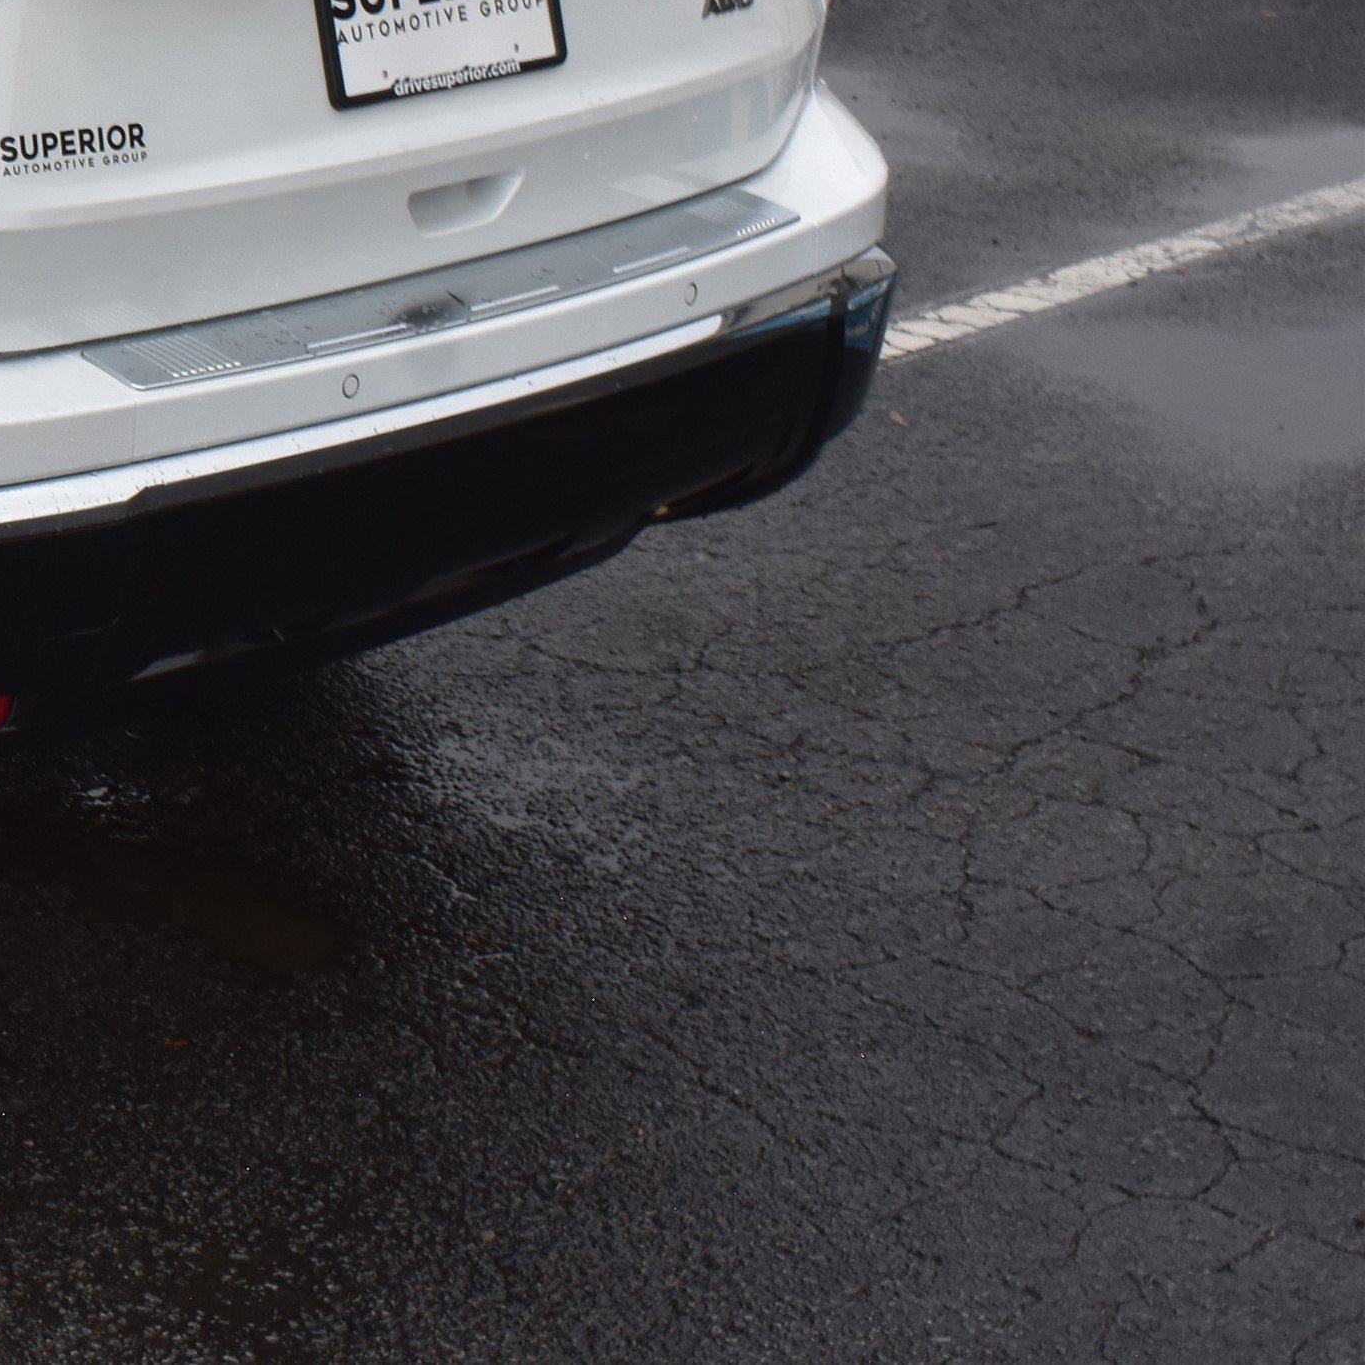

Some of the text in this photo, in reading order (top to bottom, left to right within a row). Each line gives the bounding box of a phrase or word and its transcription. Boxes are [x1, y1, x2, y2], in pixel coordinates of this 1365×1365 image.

[336, 5, 468, 46] AUTOMOTIVE
[393, 59, 521, 97] drivesuperior.com
[0, 122, 146, 163] SUPERIOR
[2, 151, 148, 177] AUTOMOTIVE GROUP
